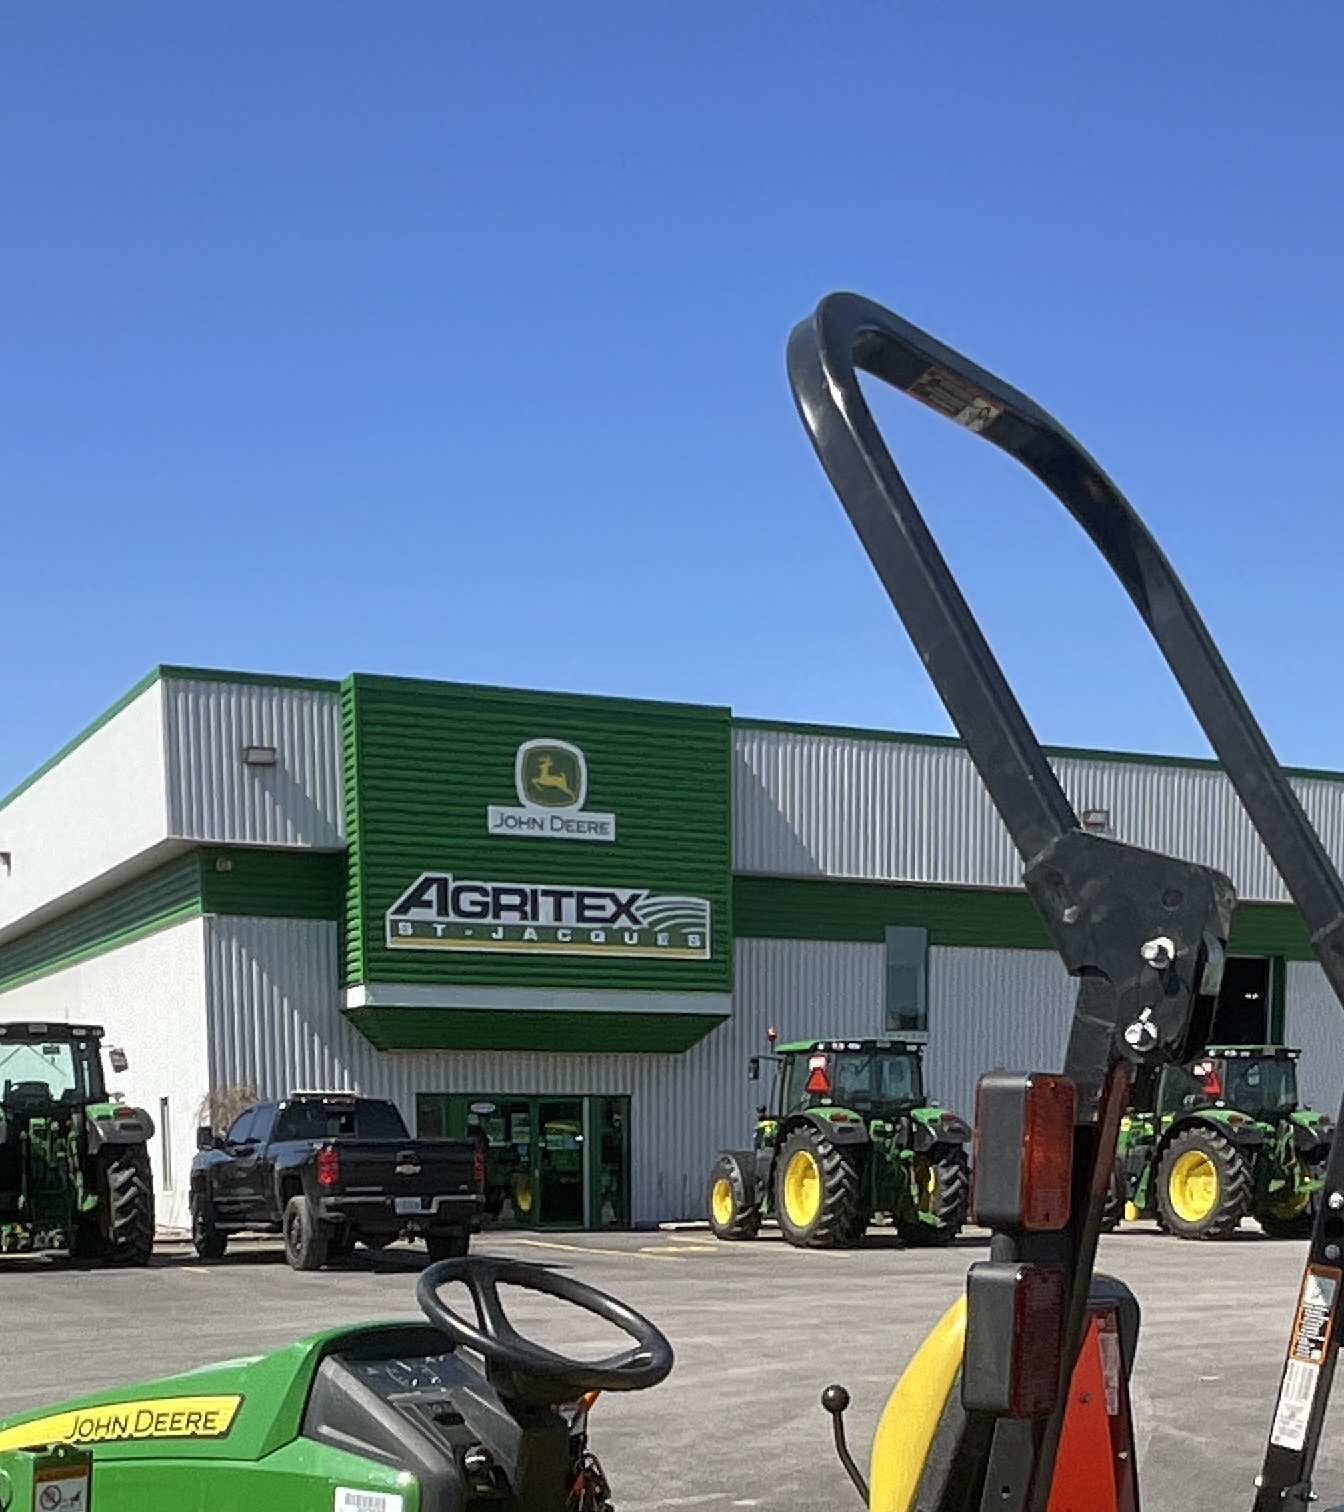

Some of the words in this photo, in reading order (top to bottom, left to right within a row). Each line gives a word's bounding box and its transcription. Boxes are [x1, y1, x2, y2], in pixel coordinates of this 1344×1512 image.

[493, 812, 545, 832] JOHN
[550, 815, 610, 836] DEERE
[390, 876, 645, 926] AGRITEX
[64, 1413, 130, 1441] JOHN
[133, 1408, 220, 1435] DEERE
